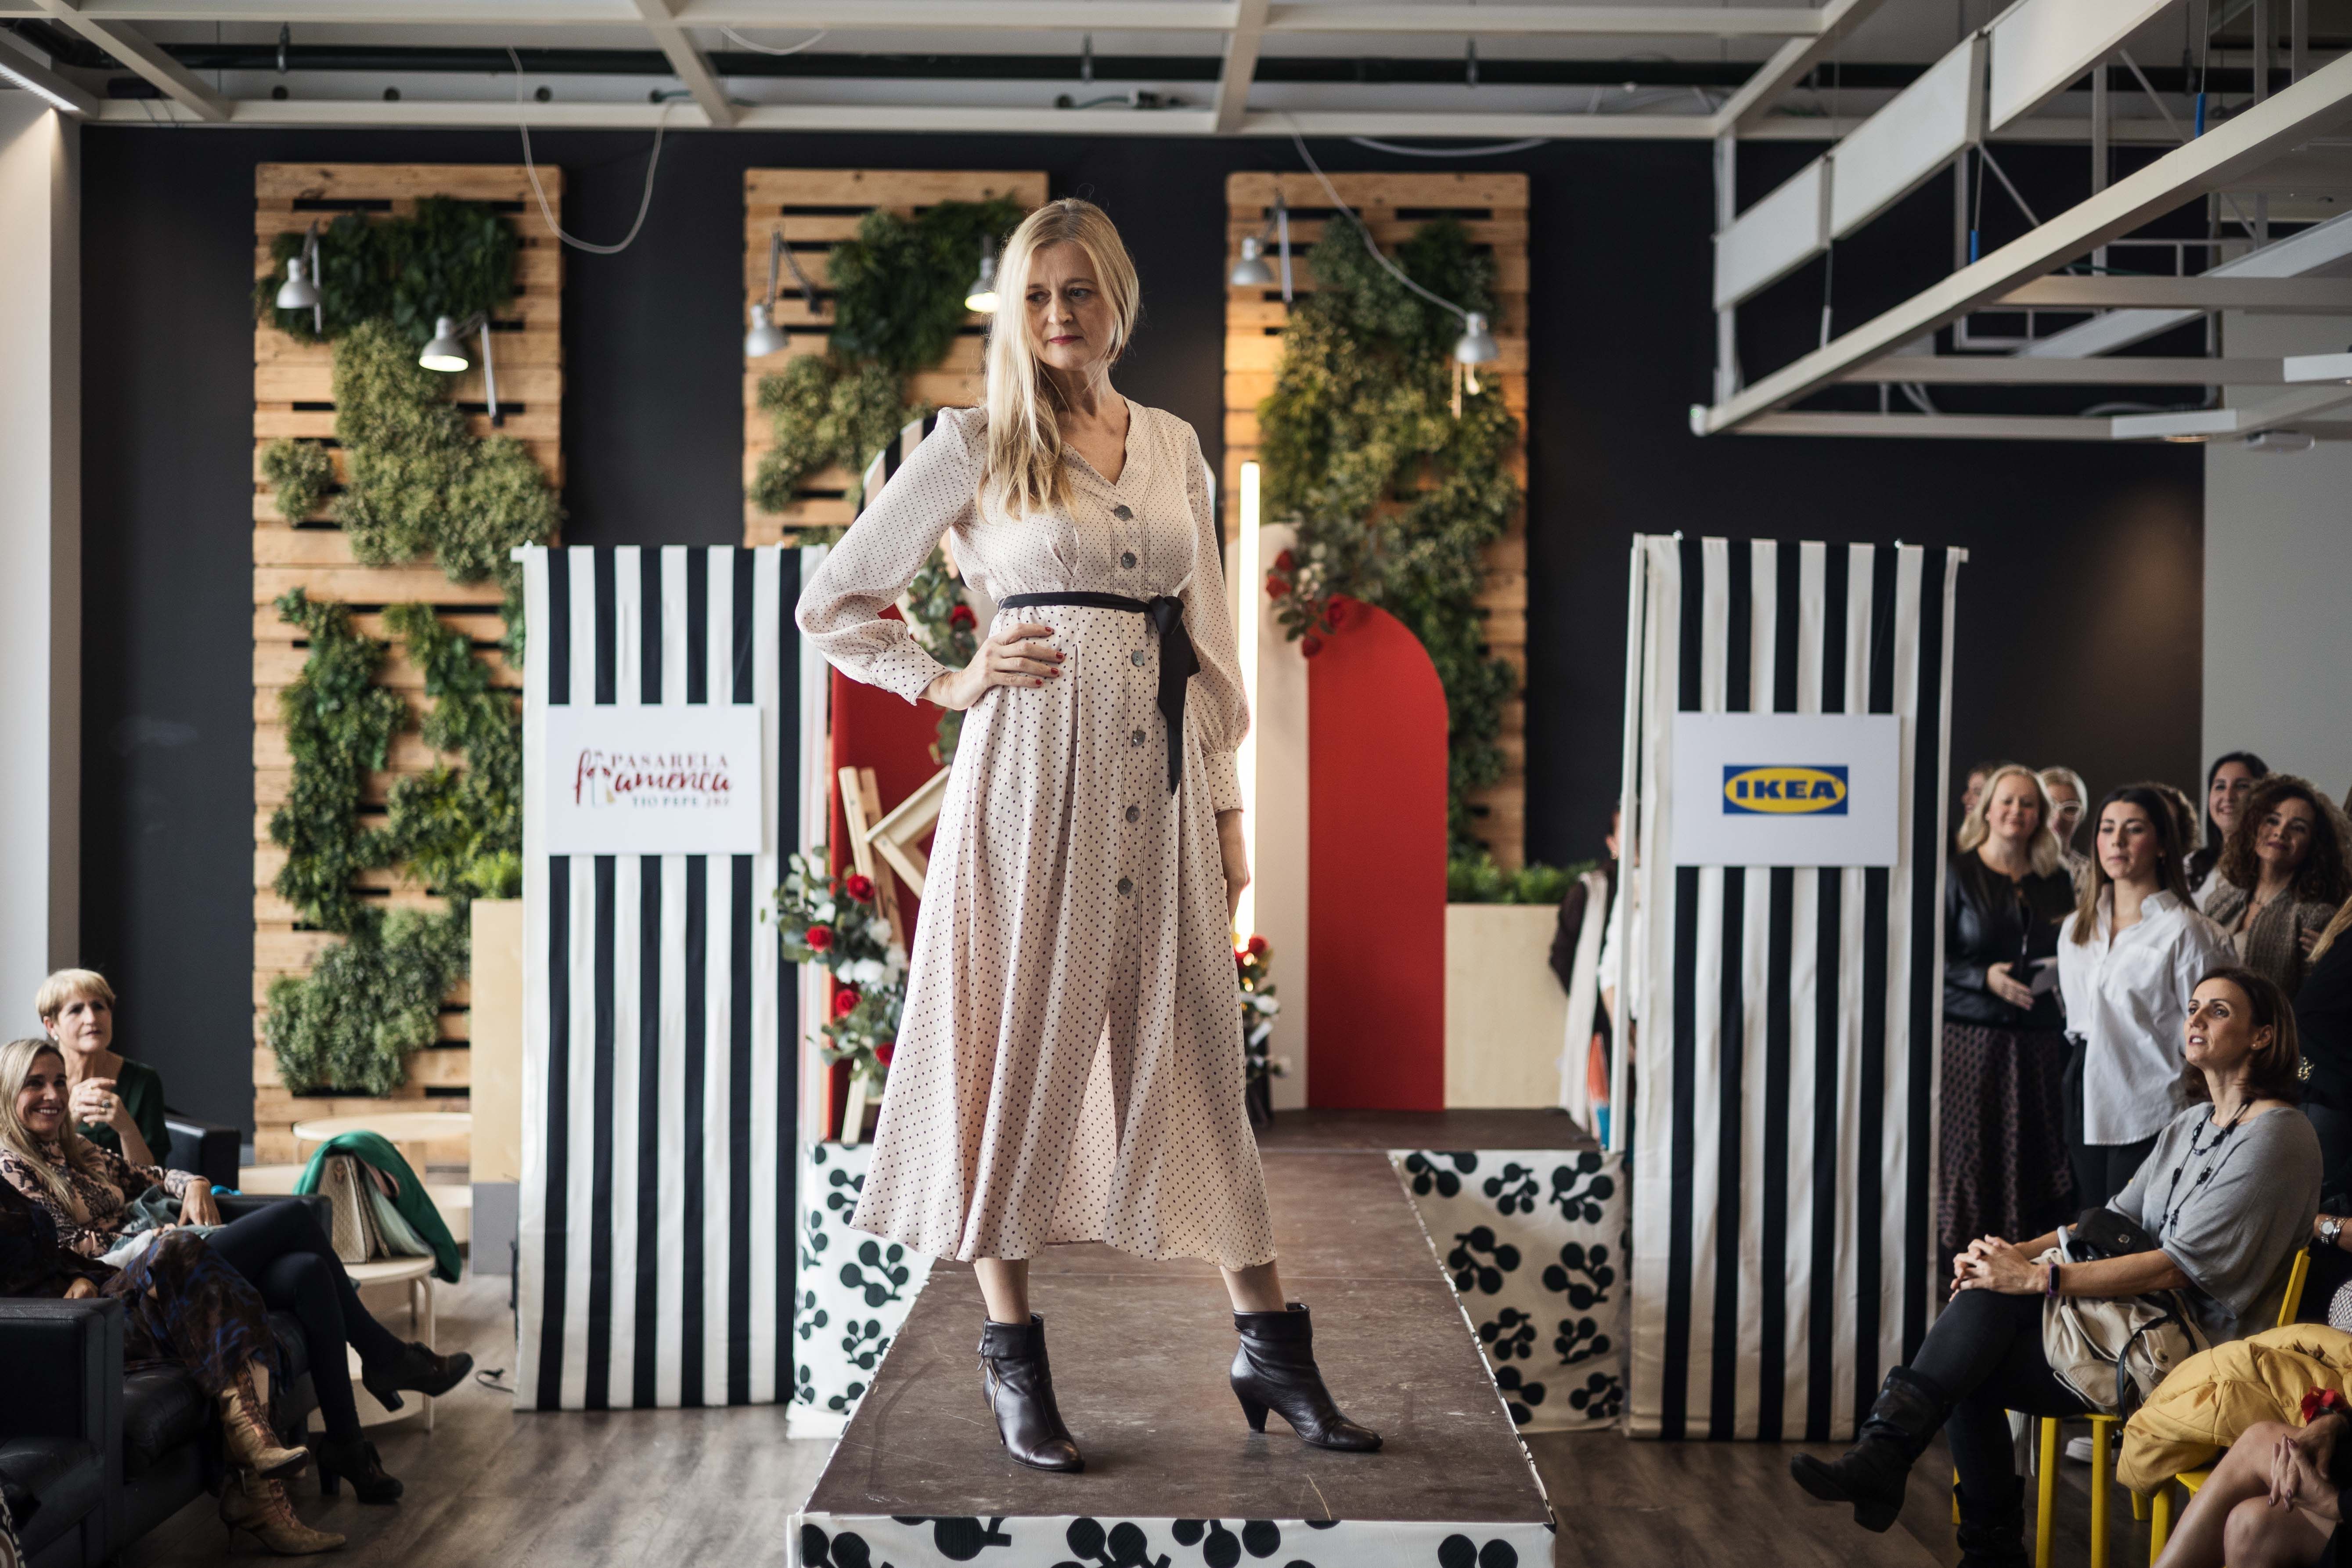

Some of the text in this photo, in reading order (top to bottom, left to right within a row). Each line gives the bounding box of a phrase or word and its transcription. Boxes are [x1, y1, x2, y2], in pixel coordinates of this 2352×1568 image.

[611, 753, 728, 768] PASARELA
[1736, 780, 1837, 800] IKEA
[663, 795, 699, 808] PEPE
